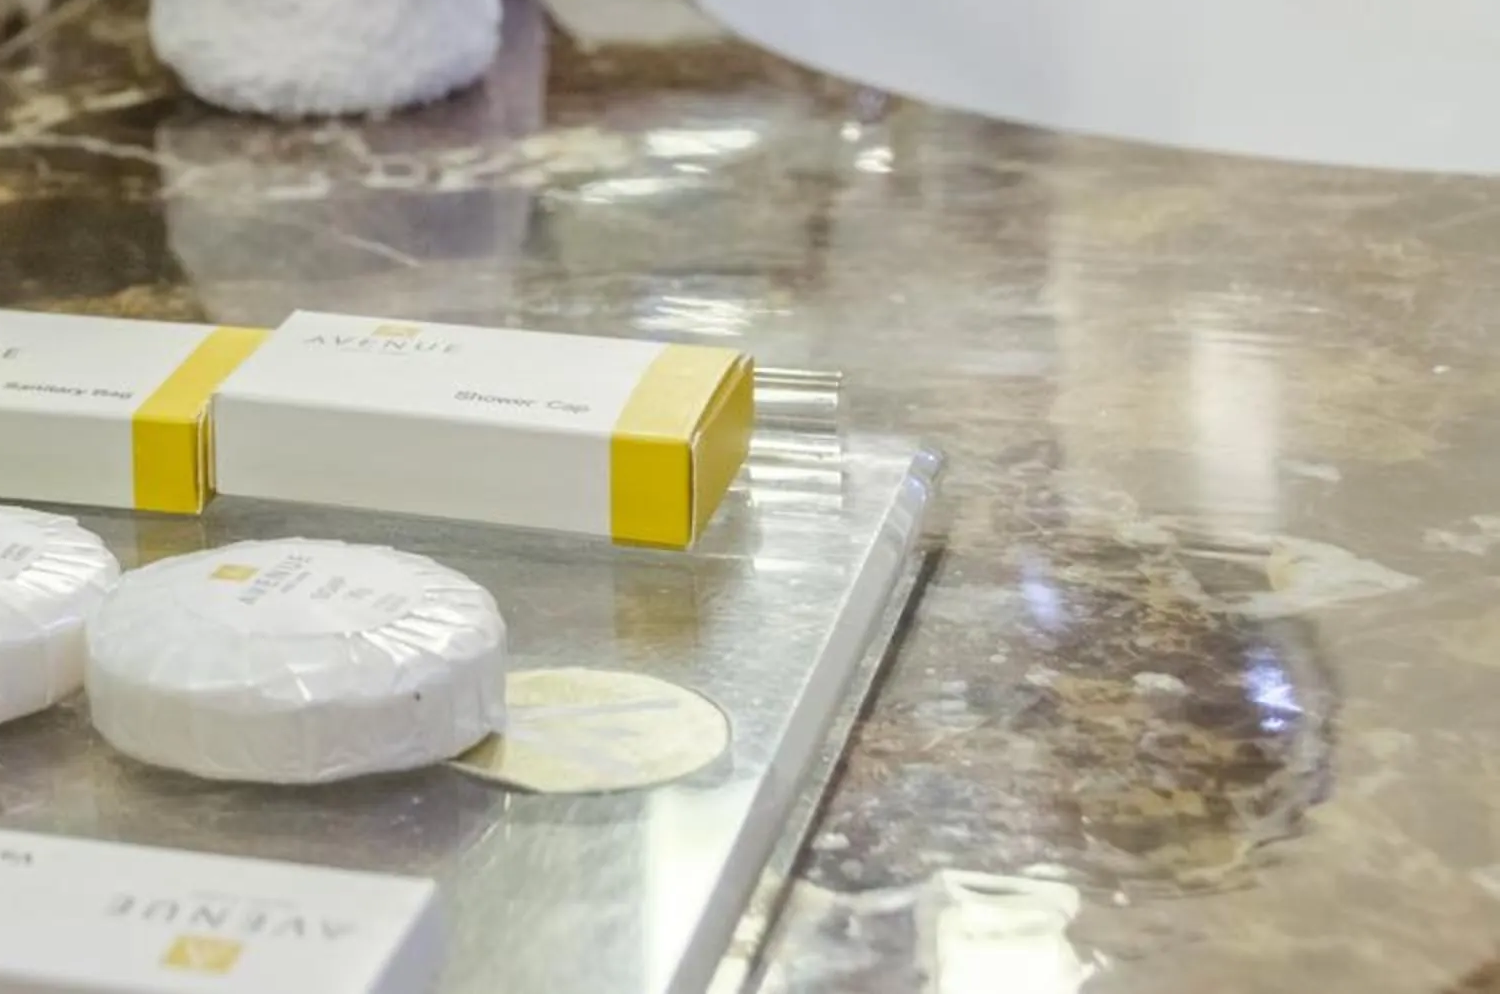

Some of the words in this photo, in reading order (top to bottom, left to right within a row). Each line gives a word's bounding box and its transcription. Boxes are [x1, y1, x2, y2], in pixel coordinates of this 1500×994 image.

[303, 334, 463, 354] AVENUE
[453, 389, 536, 408] Shower
[536, 399, 592, 414] Cap
[104, 893, 358, 940] AVENUE
